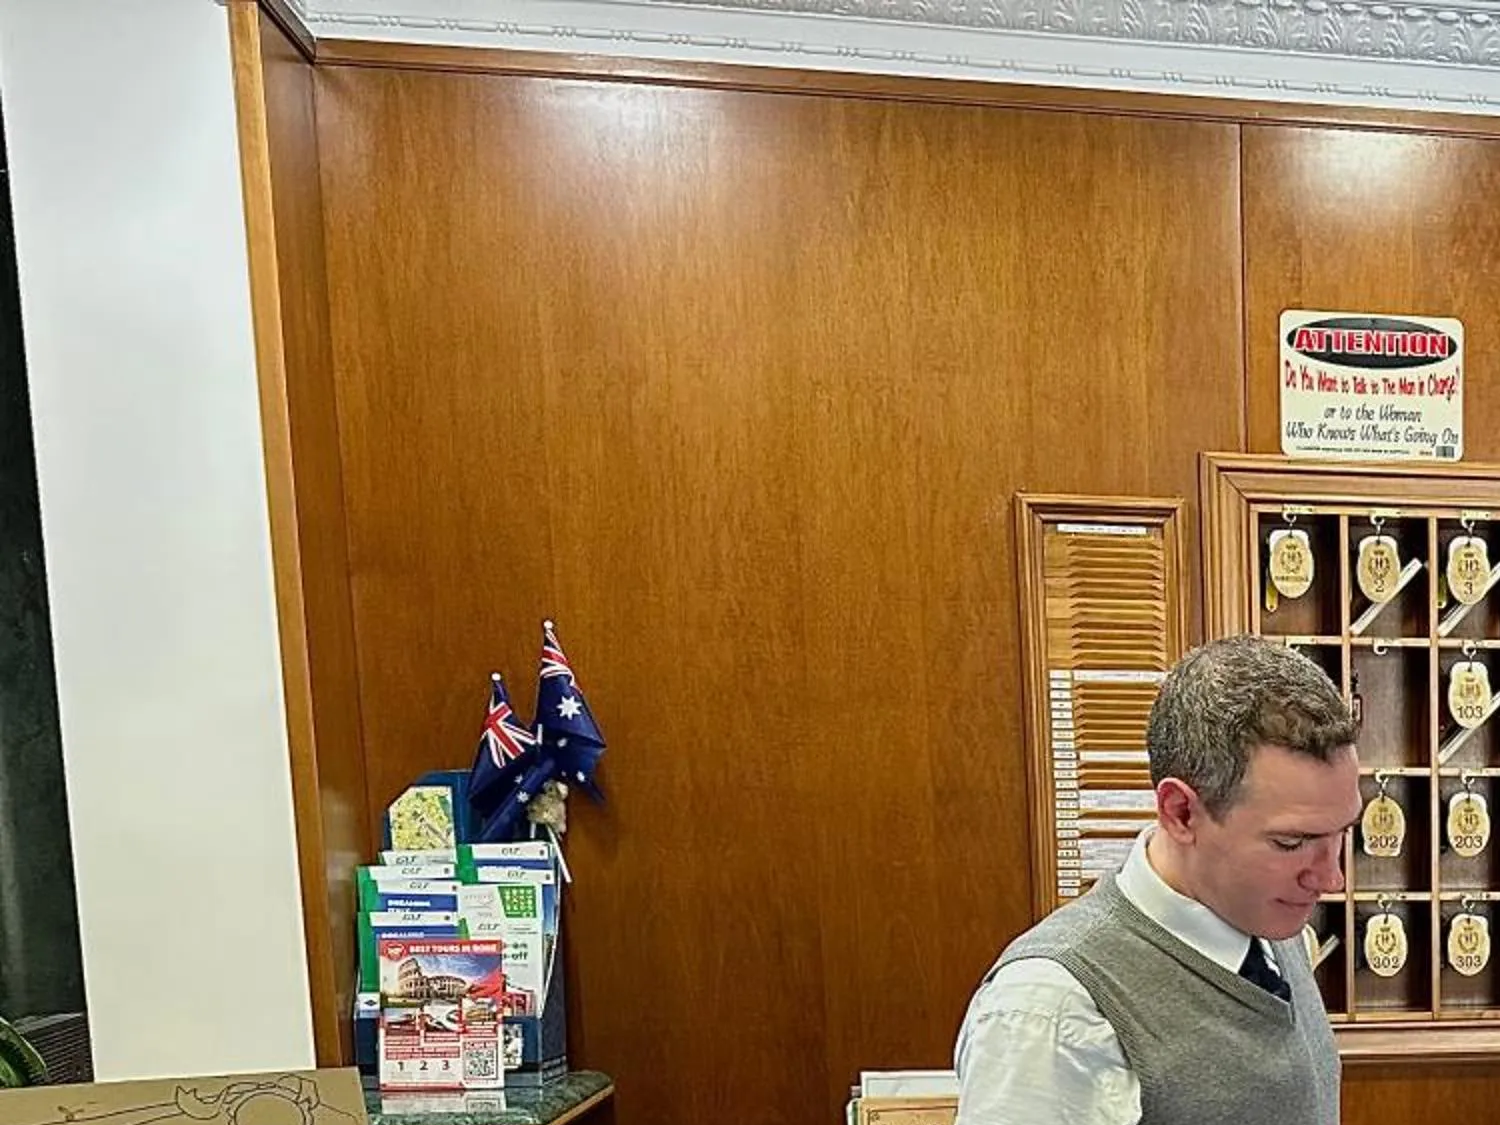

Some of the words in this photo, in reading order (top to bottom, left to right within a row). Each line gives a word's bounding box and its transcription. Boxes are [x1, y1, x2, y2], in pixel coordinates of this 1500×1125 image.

[1293, 328, 1450, 357] ATTENTION
[1284, 359, 1297, 389] Do
[1299, 365, 1314, 391] You
[1318, 370, 1339, 393] Want
[1341, 377, 1349, 394] to
[1353, 376, 1367, 395] Talk
[1371, 380, 1379, 395] to
[1382, 377, 1396, 395] The
[1400, 376, 1416, 395] Man
[1418, 376, 1425, 396] in
[1323, 406, 1337, 420] or
[1340, 405, 1353, 421] to
[1356, 402, 1375, 421] the
[1379, 404, 1423, 423] Woman
[1286, 421, 1313, 440] Who
[1317, 422, 1357, 442] Knows
[1360, 423, 1401, 444] What's
[1404, 425, 1438, 448] Going
[1441, 427, 1460, 445] On
[1374, 578, 1385, 593] 2
[1463, 582, 1473, 596] 3
[1457, 706, 1483, 720] 103
[1368, 835, 1399, 849] 202
[1455, 835, 1483, 849] 203
[1373, 956, 1400, 970] 302
[1455, 955, 1482, 970] 303
[420, 1061, 429, 1071] 2
[442, 1061, 450, 1071] 3
